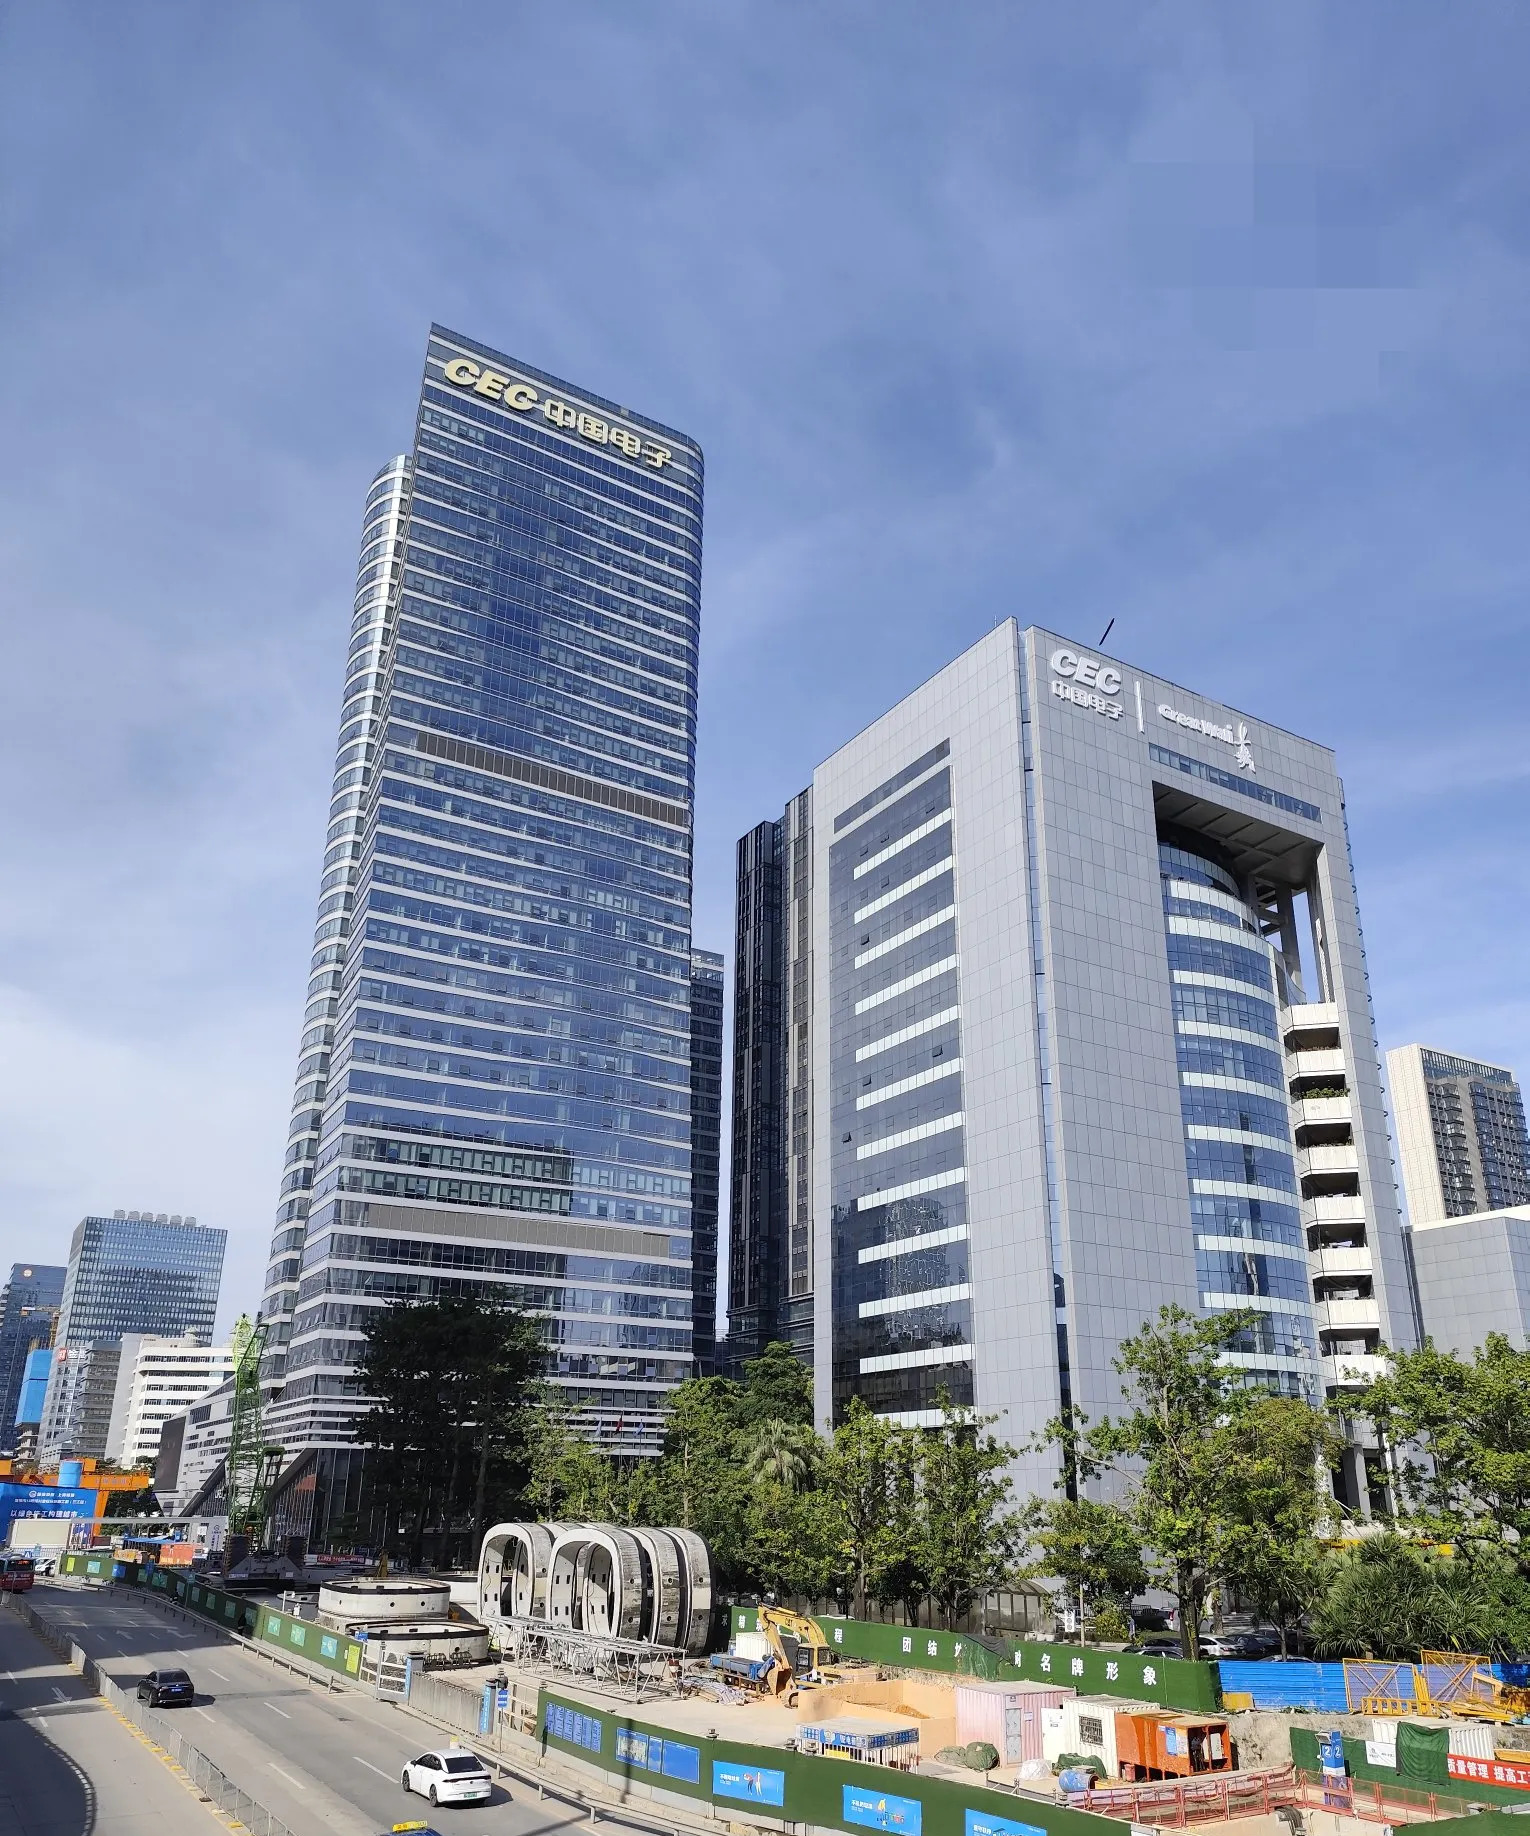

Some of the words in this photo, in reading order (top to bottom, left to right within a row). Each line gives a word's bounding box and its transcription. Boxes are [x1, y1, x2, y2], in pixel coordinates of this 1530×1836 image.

[444, 358, 538, 411] CEC
[544, 398, 672, 468] 中国电子
[1051, 649, 1122, 695] CEC
[1052, 680, 1123, 719] 中国电子
[1324, 1746, 1331, 1756] 2
[1335, 1746, 1341, 1757] 2
[1447, 1758, 1489, 1779] 质量管理
[1493, 1765, 1530, 1785] 提高工
